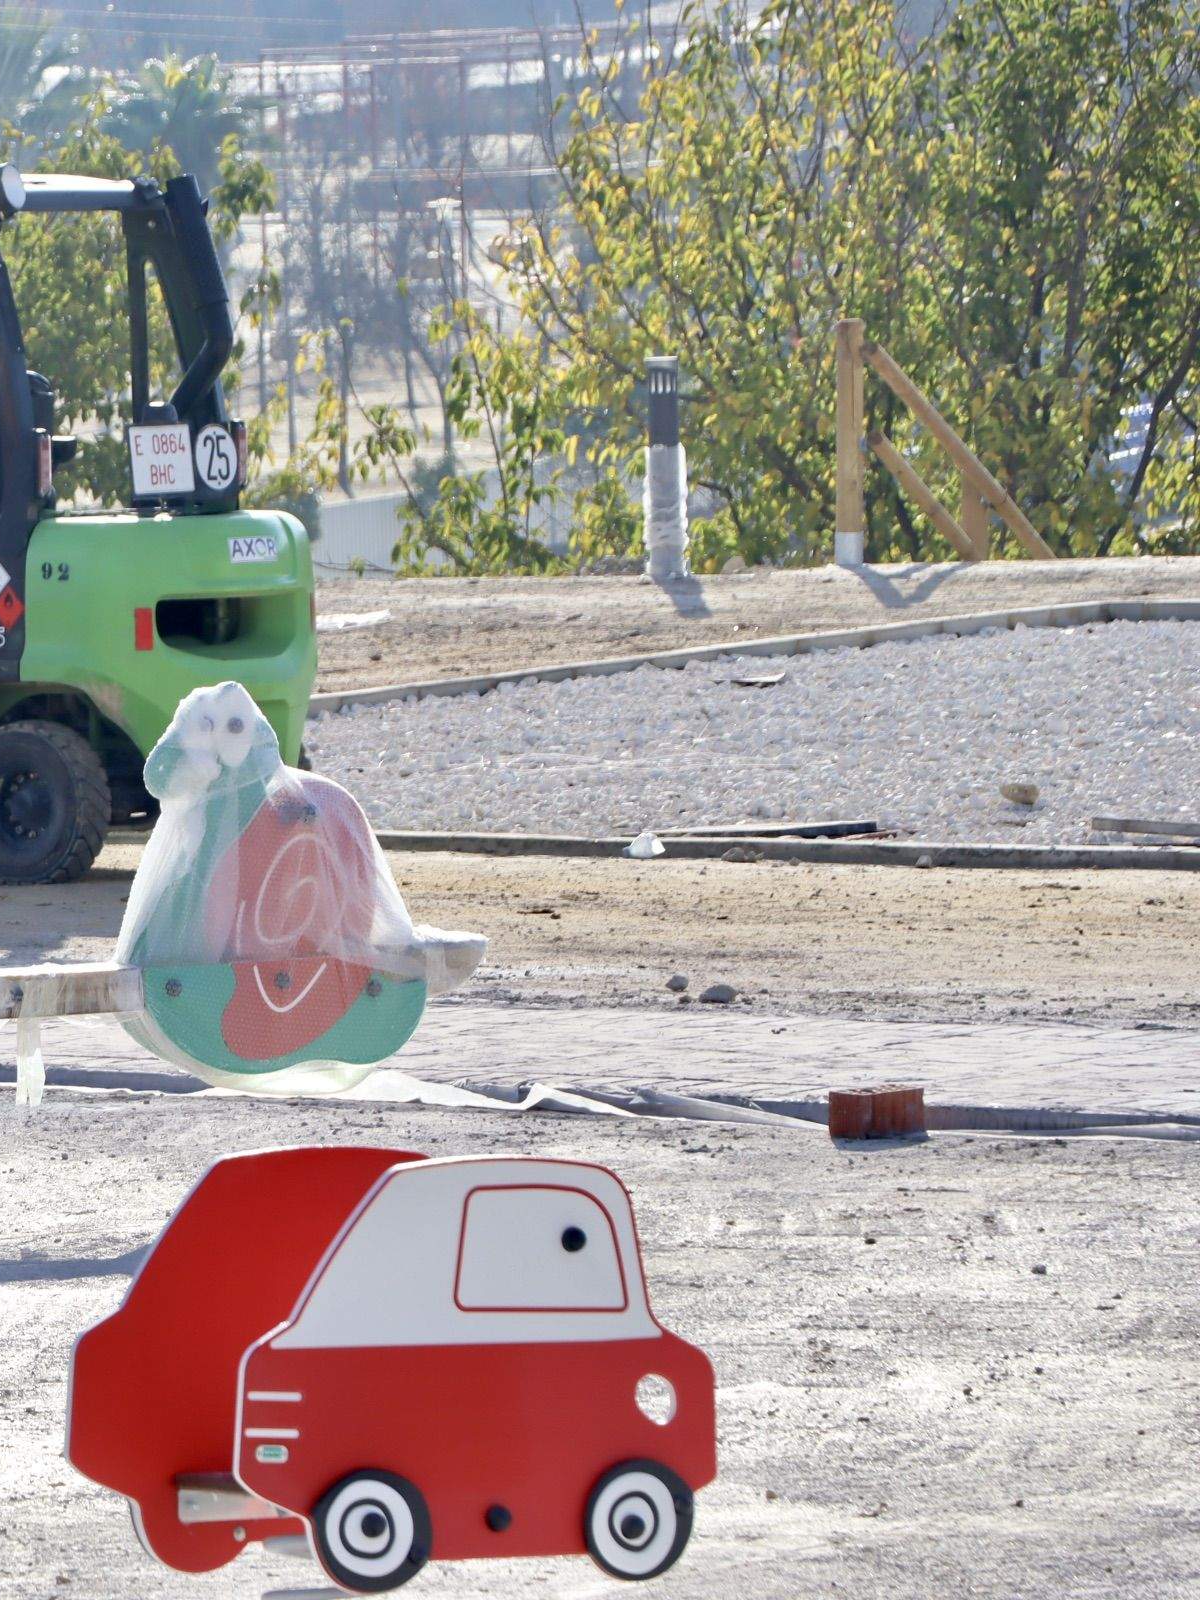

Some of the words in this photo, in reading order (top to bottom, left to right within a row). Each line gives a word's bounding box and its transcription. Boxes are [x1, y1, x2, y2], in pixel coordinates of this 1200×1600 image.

[134, 434, 144, 456] E
[151, 432, 186, 455] 0864
[203, 434, 231, 481] 25
[150, 464, 176, 486] BHC
[232, 538, 279, 558] AXOR
